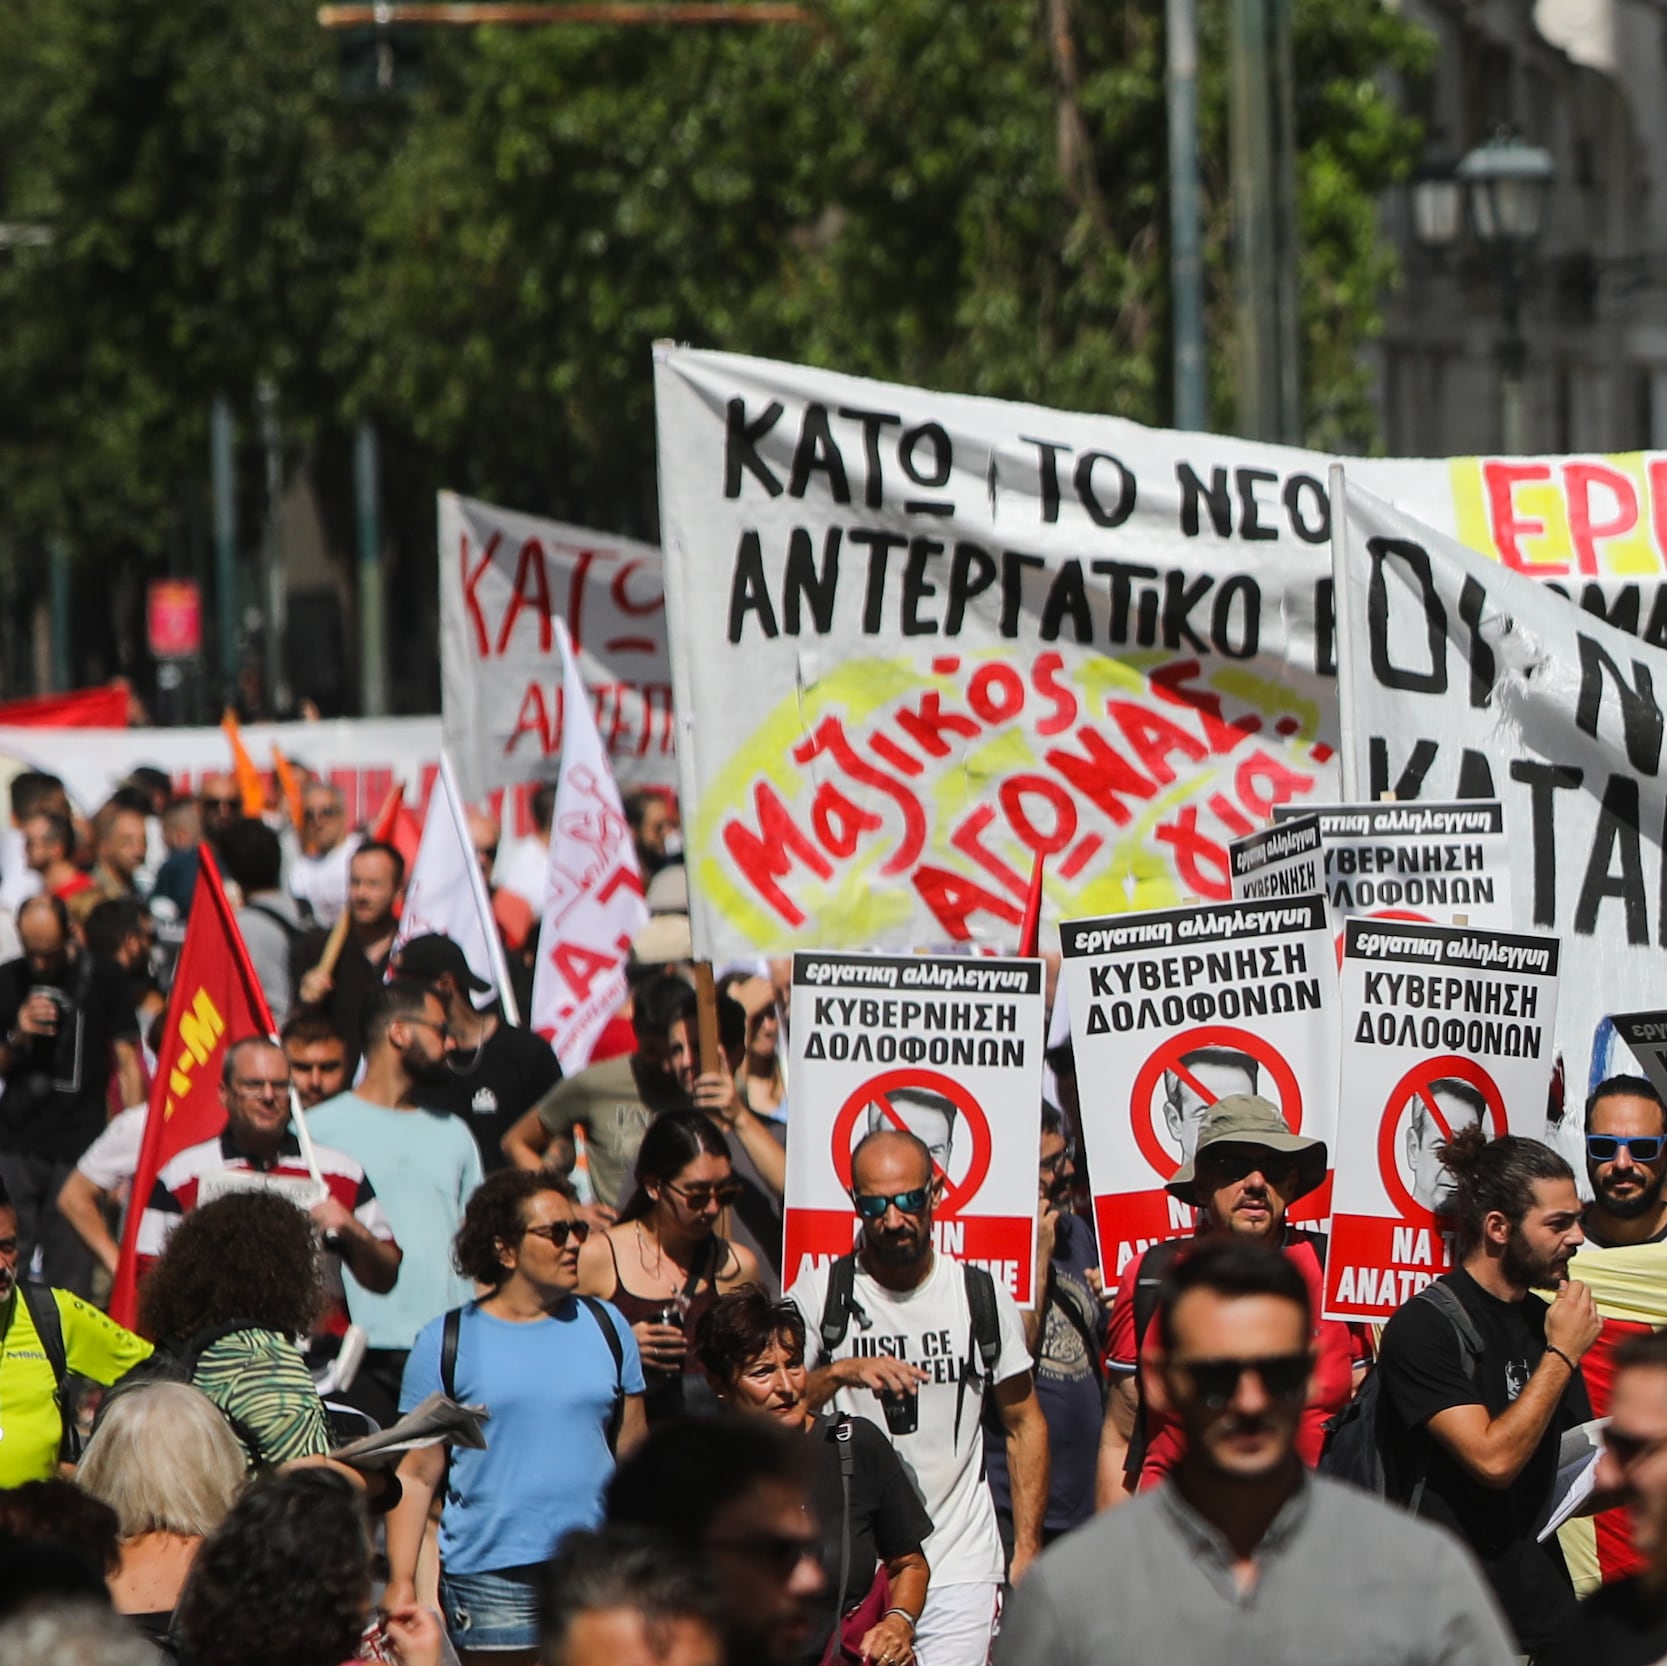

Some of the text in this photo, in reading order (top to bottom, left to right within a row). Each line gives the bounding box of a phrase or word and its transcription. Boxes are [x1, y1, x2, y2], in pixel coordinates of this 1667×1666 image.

[1018, 434, 1137, 528] ΤΟ
[1176, 462, 1331, 545] ΝΕΟ
[727, 525, 1262, 660] ΑΝΤΕΡΓΑΤΙΚΟ
[1374, 808, 1491, 834] αλληλεγγυη
[1323, 844, 1483, 875] ΥΒΕΡΝΗΣΗ
[1328, 876, 1495, 908] ΛΟΦΟΝΩΝ
[1074, 906, 1312, 953] εργατικη αλληλεγγυη
[1089, 942, 1308, 997] ΚΥΒΕΡΝΗΣΗ
[1355, 931, 1550, 973] εργατικη αλληλεγγυη
[805, 962, 1029, 992] εργατικη αλληλεγγυη
[1364, 970, 1539, 1019] ΚΥΒΕΡΝΗΣΗ
[814, 996, 1018, 1033] ΚΥΒΕΡΝΗΣΗ
[1086, 977, 1322, 1036] ΔΟΛΟΦΟΝΩΝ
[804, 1031, 1025, 1068] ΔΟΛΟΦΟΝΩΝ
[1354, 1010, 1542, 1060] ΔΟΛΟΦΟΝΩΝ
[931, 1220, 965, 1255] ΗΝ
[1390, 1225, 1433, 1267] ΝΑ
